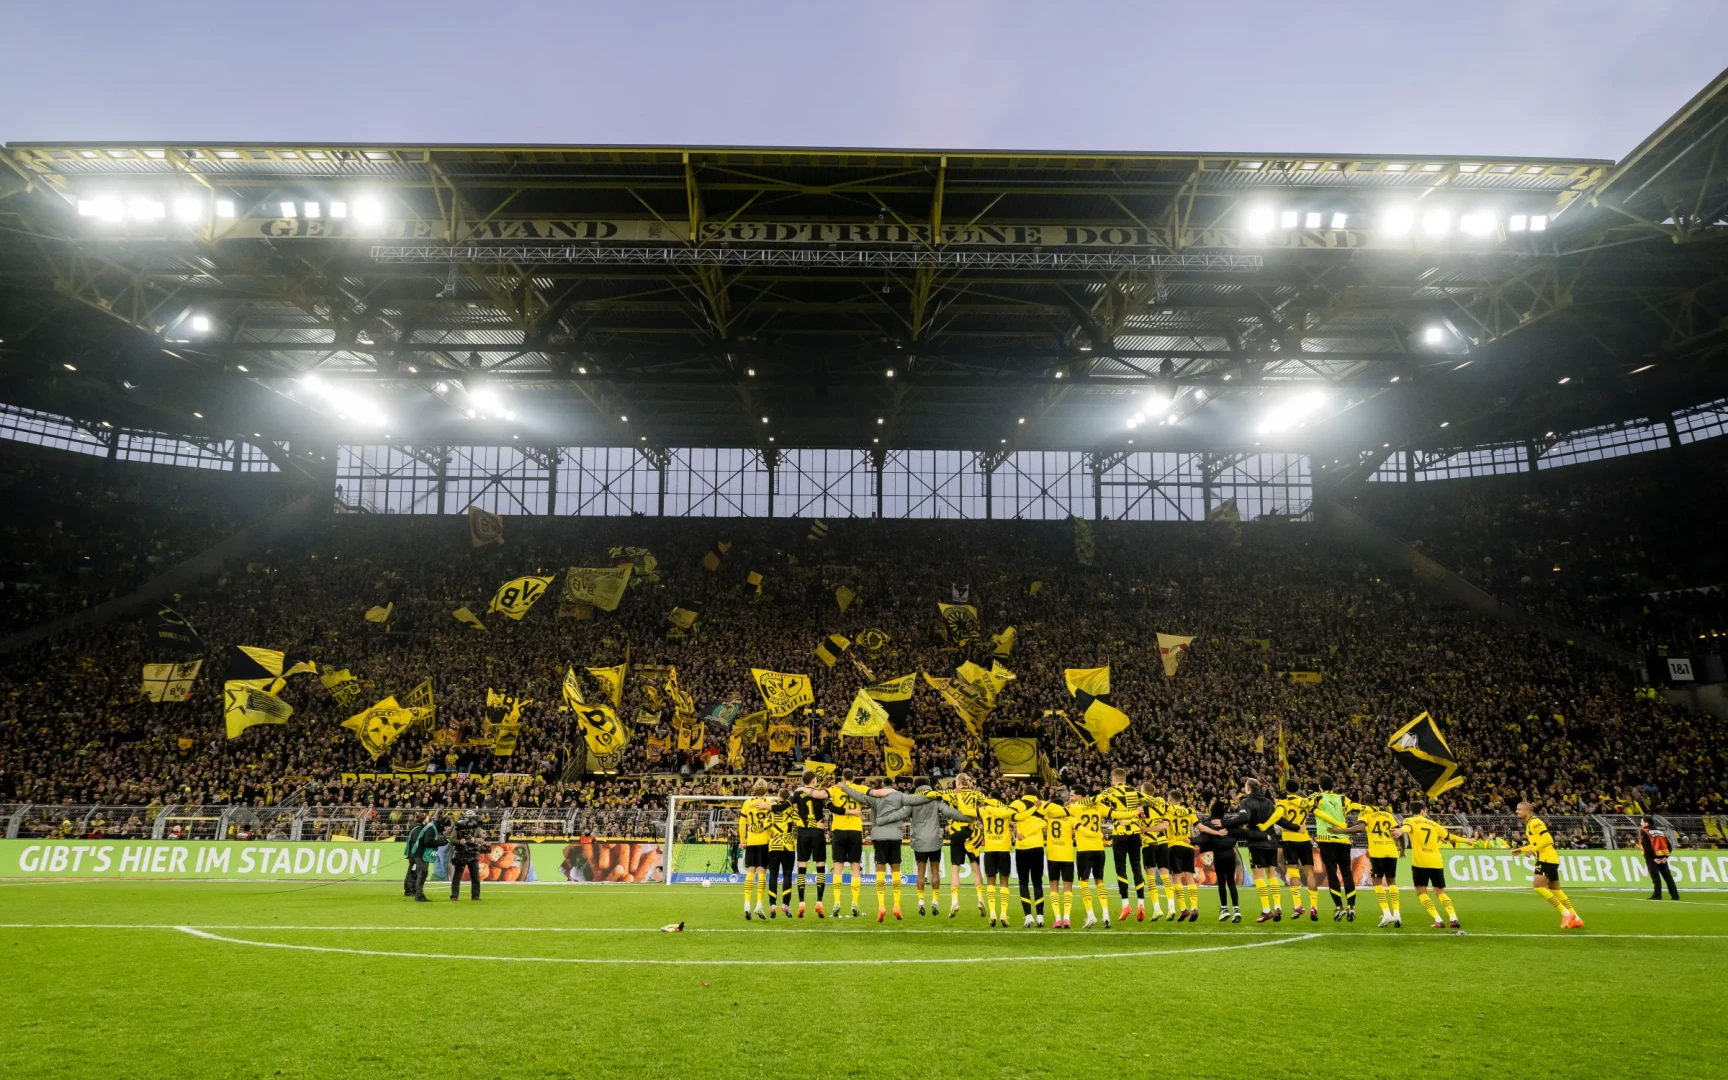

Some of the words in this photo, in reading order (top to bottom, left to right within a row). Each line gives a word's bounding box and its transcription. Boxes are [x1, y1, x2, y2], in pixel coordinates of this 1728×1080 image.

[260, 219, 433, 238] GELE
[467, 220, 618, 241] WAND
[1064, 226, 1368, 248] DORTND
[1671, 663, 1690, 675] 1&1
[805, 800, 816, 820] 1
[840, 795, 857, 810] 25
[986, 816, 1004, 835] 18
[1080, 813, 1100, 832] 23
[1288, 809, 1308, 825] 22
[1051, 820, 1061, 839] 8
[1172, 818, 1189, 836] 13
[1372, 820, 1391, 838] 43
[1421, 827, 1431, 845] 7
[19, 845, 113, 873] GIBT'S
[119, 846, 187, 874] HIER
[195, 847, 232, 874] IM
[237, 847, 380, 875] STADION!
[1449, 855, 1536, 882] GIBT'S
[1558, 856, 1617, 882] HIER
